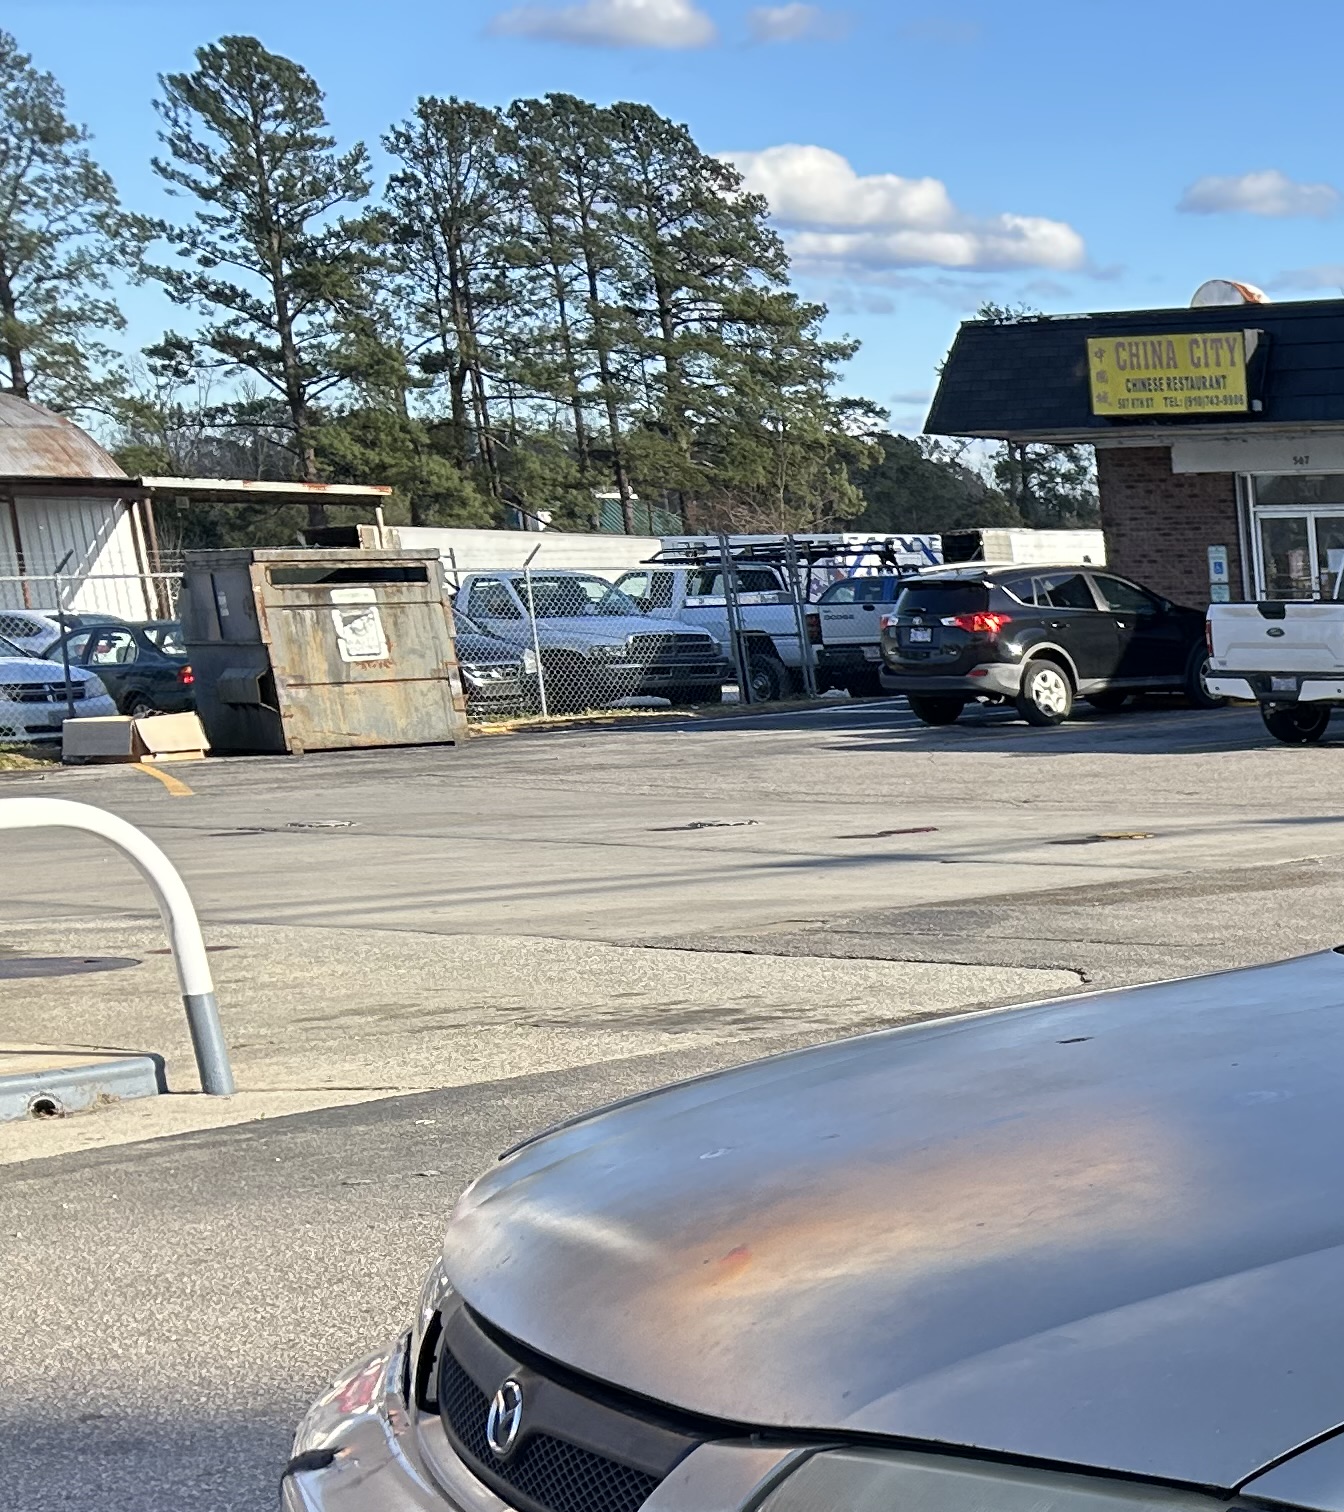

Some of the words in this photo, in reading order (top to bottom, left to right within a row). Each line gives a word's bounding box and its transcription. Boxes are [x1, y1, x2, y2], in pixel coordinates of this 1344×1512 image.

[1114, 340, 1179, 371] CHINA
[1188, 337, 1238, 369] CITY
[1125, 376, 1164, 394] CHINESE
[1166, 374, 1227, 392] RESTAURANT
